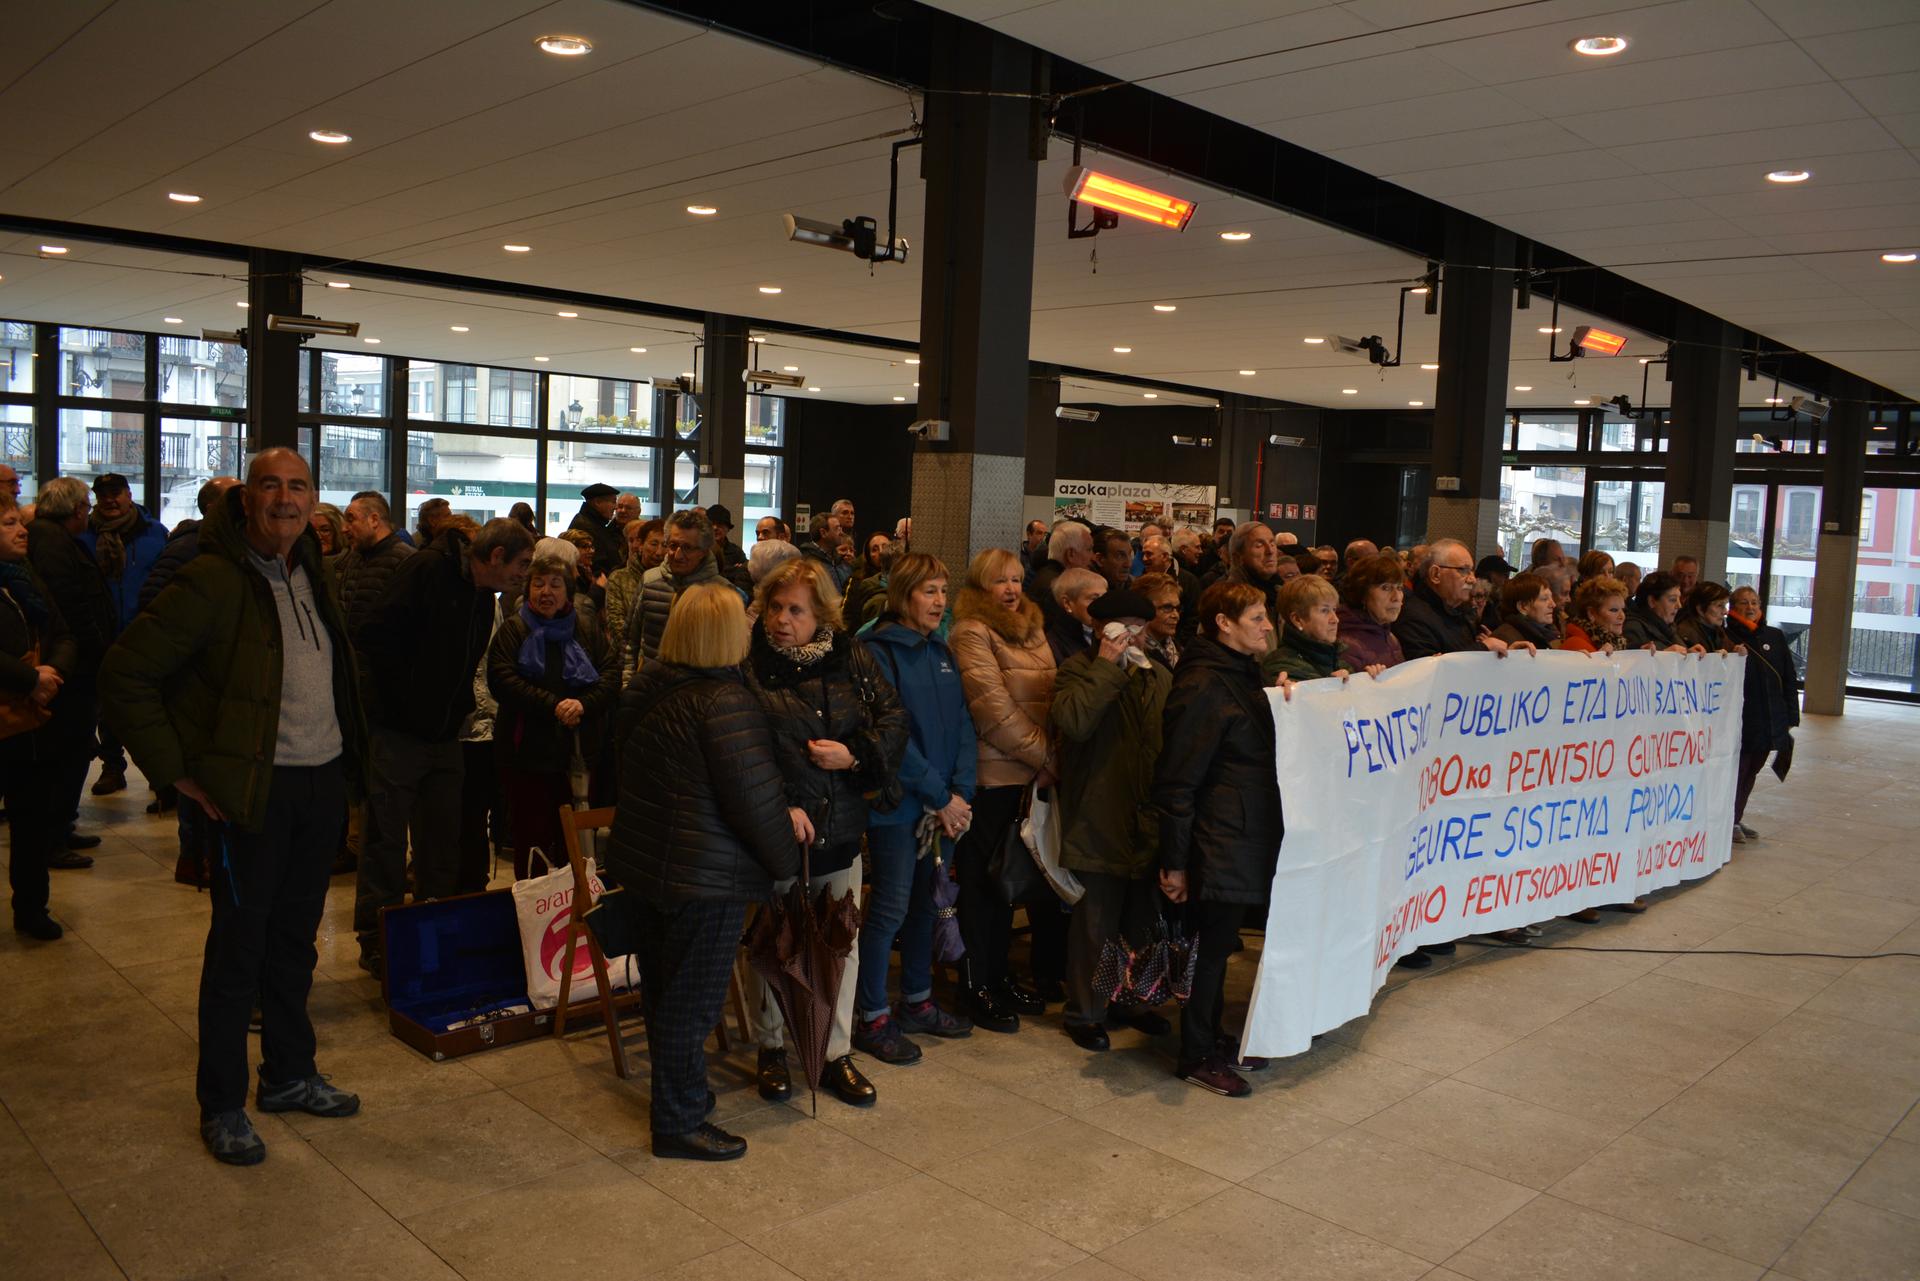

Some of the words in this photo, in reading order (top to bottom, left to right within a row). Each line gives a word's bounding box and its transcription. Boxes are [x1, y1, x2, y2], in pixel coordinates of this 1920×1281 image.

[464, 485, 484, 493] RURAL
[1059, 483, 1151, 498] azokaplaza
[1342, 703, 1431, 778] PENTSIO
[1440, 685, 1550, 738] PUBLIKO
[1562, 677, 1607, 725] ETA
[1615, 675, 1650, 719] DUIN
[1506, 738, 1615, 794] PENTSIO
[1494, 795, 1609, 859] SISTEMA
[1462, 851, 1621, 919] PENTSIODUNEN
